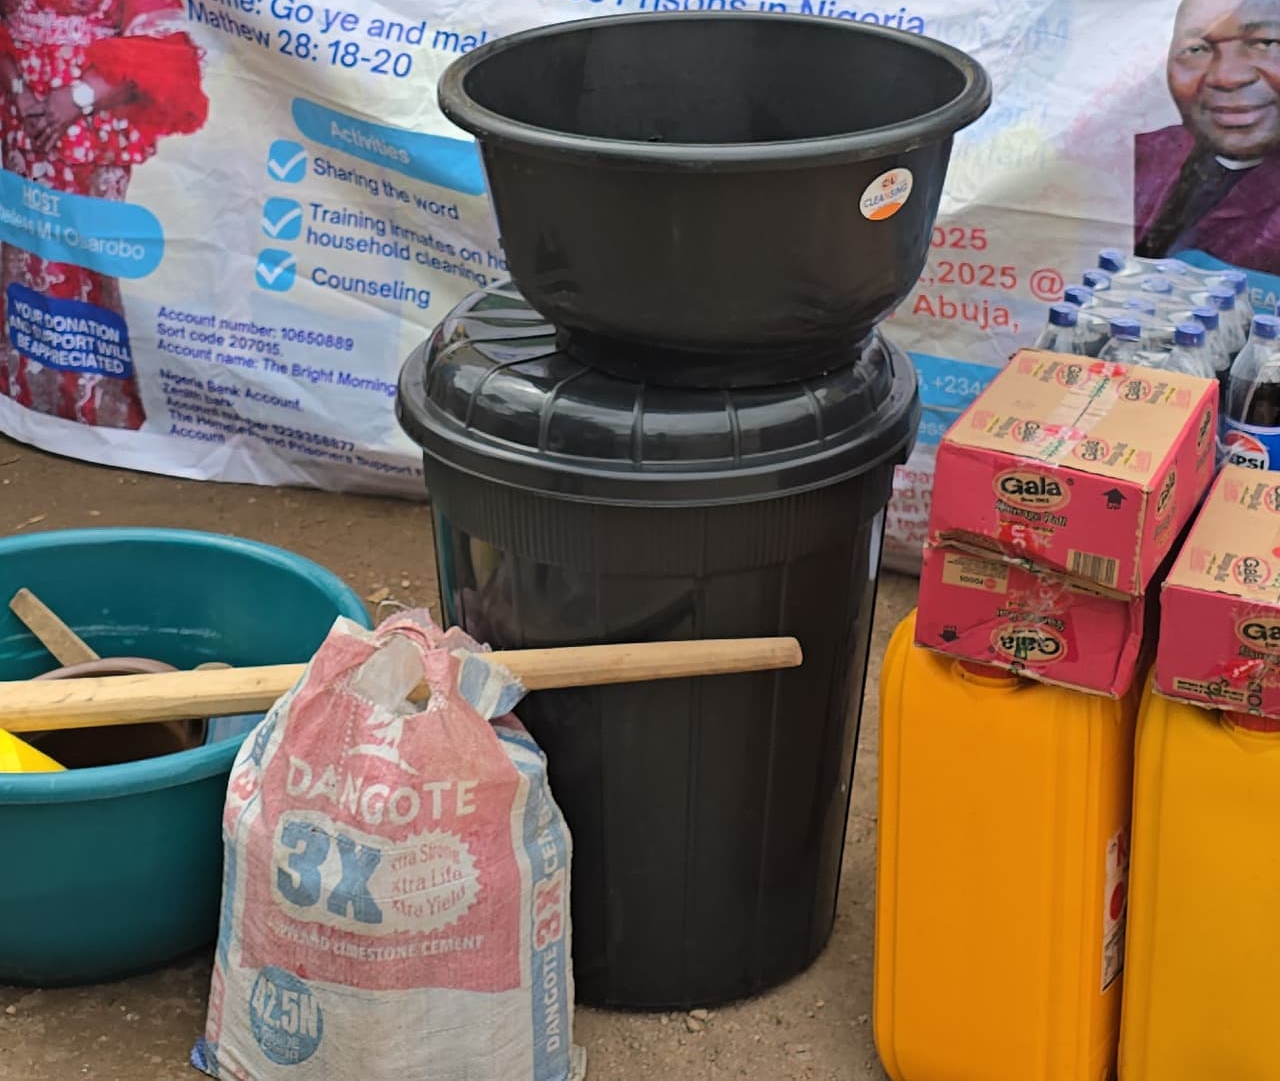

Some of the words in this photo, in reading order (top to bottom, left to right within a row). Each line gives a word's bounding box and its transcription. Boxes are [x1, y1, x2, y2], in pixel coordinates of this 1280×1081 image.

[320, 8, 360, 34] ye
[367, 19, 427, 46] and
[278, 29, 318, 62] 28:
[327, 39, 413, 79] 18-20
[330, 120, 410, 165] Activities
[23, 186, 61, 216] HOST
[313, 157, 379, 197] Sharing
[382, 180, 411, 204] the
[413, 196, 460, 220] word
[64, 226, 146, 260] Oarobo
[310, 203, 387, 237] Training
[389, 220, 455, 256] inmates
[459, 247, 483, 265] on
[930, 226, 988, 251] 025
[306, 226, 411, 261] household
[415, 252, 488, 288] cleaning
[311, 266, 431, 309] Counseling
[1029, 268, 1064, 302] @
[44, 316, 120, 343] DONATION
[157, 306, 216, 329] Account
[220, 317, 277, 340] number:
[913, 294, 1019, 333] Abuja,
[96, 341, 131, 362] WILL
[157, 323, 186, 339] Sort
[189, 328, 225, 346] code
[32, 337, 124, 374] APPRECIATED
[157, 339, 213, 362] Account
[217, 351, 258, 370] name:
[262, 357, 293, 375] The
[291, 364, 334, 386] Bright
[336, 371, 398, 398] Morning
[207, 380, 241, 397] Bank
[170, 424, 226, 444] Account
[1001, 476, 1062, 497] Gala
[286, 755, 480, 825] DANGOTE
[277, 821, 383, 924] 3X
[432, 865, 463, 888] Life
[426, 884, 466, 916] Yield
[535, 879, 563, 950] 3X
[421, 933, 485, 955] CEMENT
[543, 946, 561, 1054] DANGOTE
